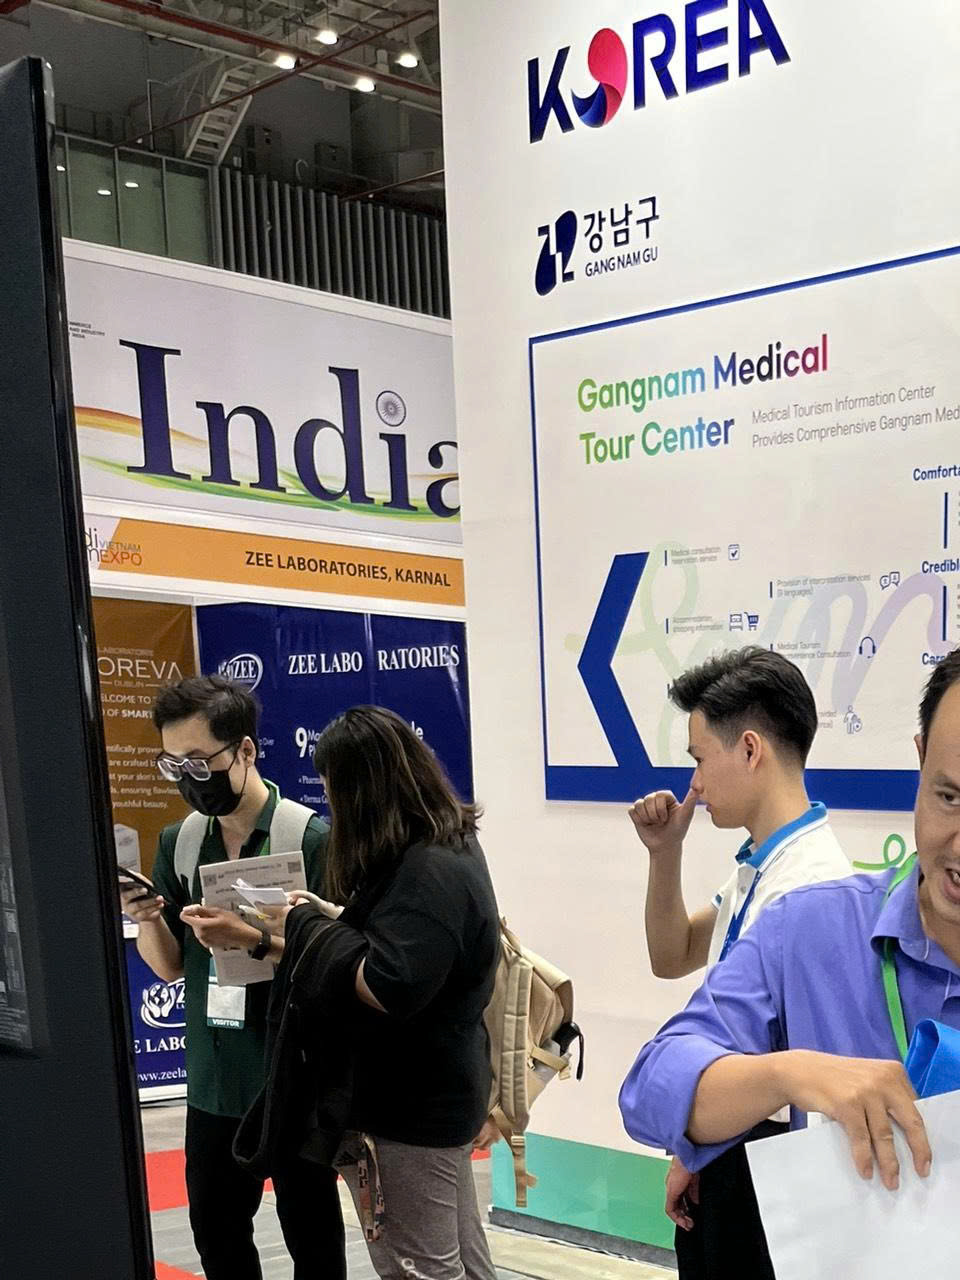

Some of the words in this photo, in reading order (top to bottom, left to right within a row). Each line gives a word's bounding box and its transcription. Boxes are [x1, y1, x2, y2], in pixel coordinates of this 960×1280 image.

[527, 0, 791, 144] KOREA
[583, 196, 660, 253] 강남구
[585, 256, 616, 277] GANG
[616, 251, 641, 270] NAM
[642, 246, 658, 263] GU
[577, 366, 706, 414] Gangnam
[713, 333, 828, 390] Medical
[752, 403, 791, 425] Medical
[793, 399, 833, 418] Tourism
[834, 391, 896, 413] Information
[898, 385, 936, 402] Center
[119, 338, 461, 519] India
[579, 431, 636, 465] Tour
[641, 416, 736, 457] Center
[752, 429, 794, 448] Provides
[796, 418, 877, 444] Comprehensive
[879, 411, 932, 431] Gangnam
[244, 551, 275, 570] ZEE
[276, 553, 393, 583] LABORATORIES,
[395, 566, 452, 588] KARNAL
[234, 659, 258, 679] ZEE
[288, 654, 318, 676] ZEE
[377, 644, 461, 671] RATORIES
[107, 708, 120, 717] OF
[137, 695, 152, 705] TO
[295, 726, 308, 758] 9
[213, 1018, 240, 1028] VISITOR
